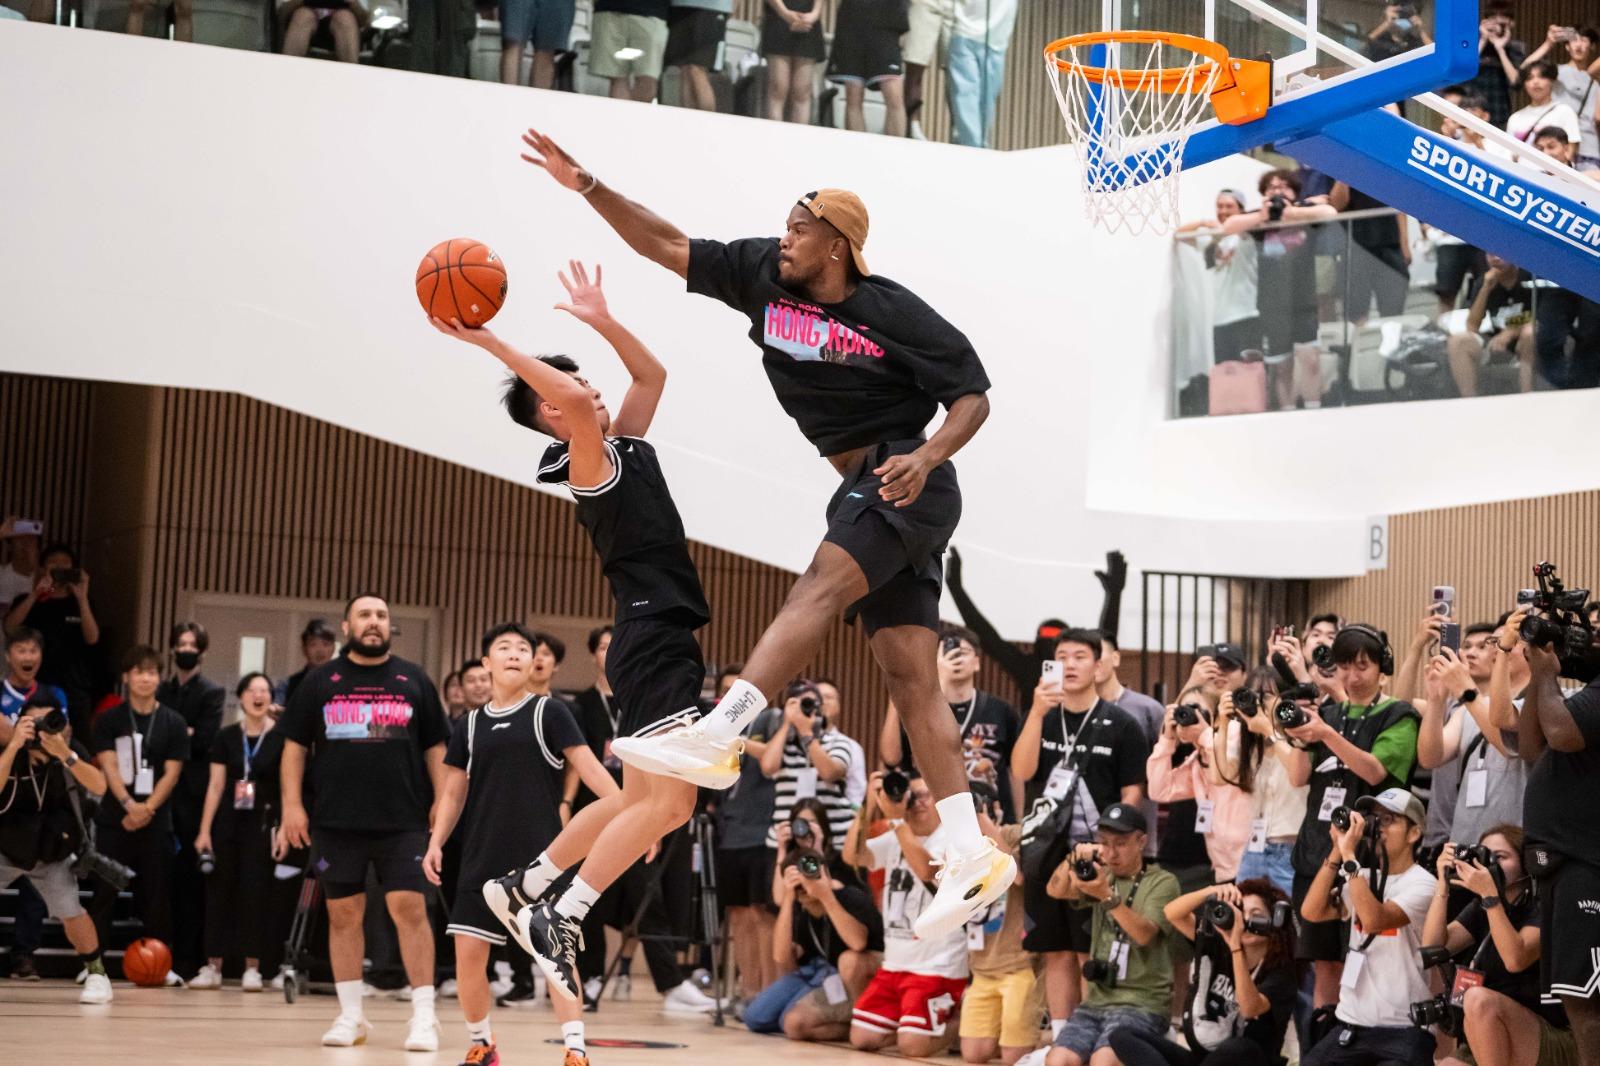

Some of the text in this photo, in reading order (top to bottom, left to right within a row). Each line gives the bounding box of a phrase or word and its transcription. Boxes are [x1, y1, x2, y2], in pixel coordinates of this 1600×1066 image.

[1411, 136, 1504, 198] SPORT
[768, 302, 823, 348] HONG
[1370, 525, 1383, 560] B
[325, 700, 410, 726] HONG KONG
